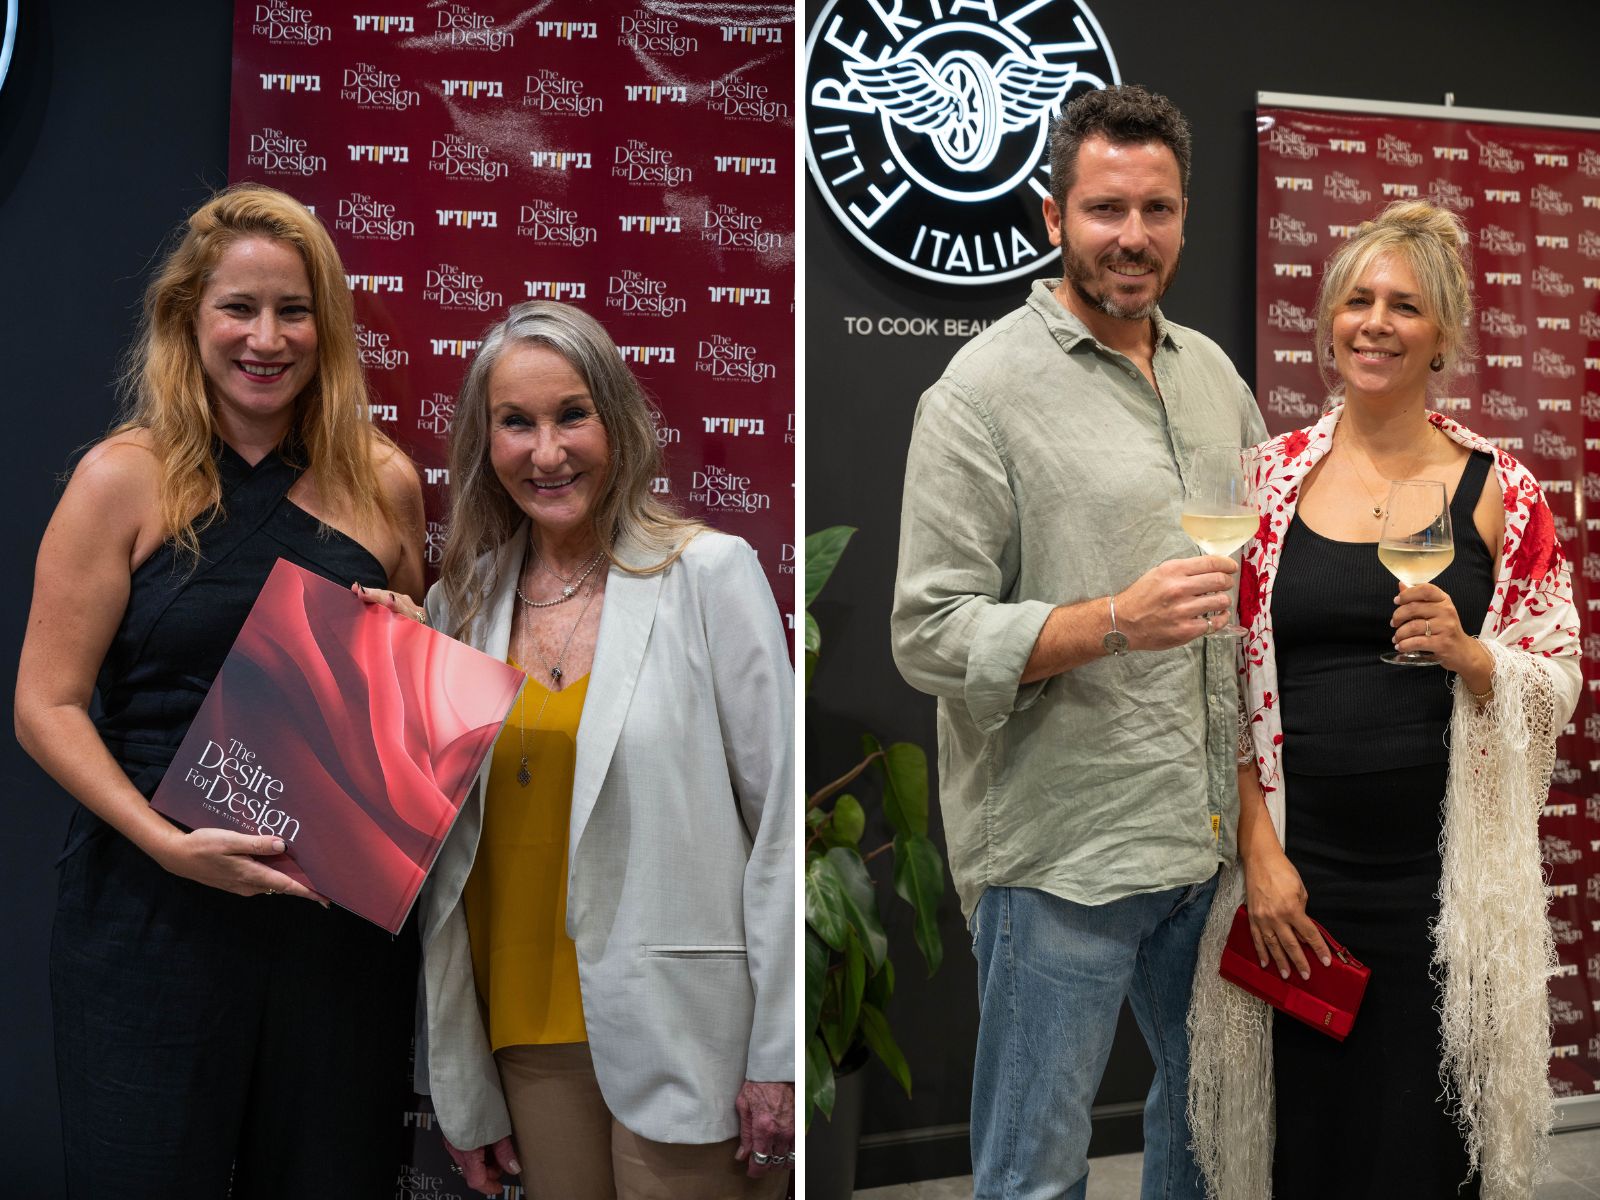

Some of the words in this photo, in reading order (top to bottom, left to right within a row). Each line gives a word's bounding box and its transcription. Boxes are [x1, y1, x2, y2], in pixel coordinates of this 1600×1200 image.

[255, 4, 312, 23] Desire
[450, 4, 470, 14] The
[633, 8, 652, 19] The
[438, 10, 494, 29] Desire
[620, 15, 678, 34] Desire
[252, 24, 269, 36] For
[269, 22, 332, 46] Design
[435, 30, 451, 41] For
[451, 28, 514, 52] Design
[634, 33, 697, 57] Design
[356, 62, 376, 73] The
[539, 68, 558, 79] The
[344, 69, 400, 88] Desire
[526, 75, 584, 94] Desire
[723, 74, 742, 84] The
[710, 80, 768, 99] Desire
[341, 89, 357, 100] For
[357, 87, 420, 111] Design
[524, 95, 540, 106] For
[540, 93, 603, 117] Design
[708, 100, 724, 111] For
[724, 98, 787, 122] Design
[263, 128, 282, 138] The
[444, 134, 464, 144] The
[1271, 130, 1307, 145] Desire
[250, 134, 308, 153] Desire
[432, 140, 488, 159] Desire
[628, 140, 648, 150] The
[1279, 143, 1319, 160] Design
[1377, 137, 1411, 152] Desire
[1479, 144, 1513, 159] Desire
[248, 154, 264, 165] For
[264, 152, 327, 176] Design
[616, 146, 672, 165] Desire
[1386, 150, 1423, 166] Design
[429, 160, 445, 171] For
[445, 158, 508, 182] Design
[1488, 157, 1525, 173] Design
[613, 166, 629, 177] For
[629, 164, 692, 188] Design
[1324, 174, 1360, 190] Desire
[351, 192, 370, 203] The
[1333, 188, 1372, 204] Design
[1531, 188, 1562, 201] Desire
[338, 199, 396, 218] Desire
[533, 198, 552, 209] The
[716, 204, 737, 214] The
[1539, 199, 1573, 214] Design
[520, 205, 578, 224] Desire
[704, 210, 762, 230] Desire
[336, 219, 352, 230] For
[352, 217, 415, 241] Design
[1270, 217, 1306, 232] Desire
[518, 225, 534, 236] For
[534, 223, 597, 247] Design
[701, 231, 718, 242] For
[718, 229, 782, 253] Design
[1278, 230, 1318, 247] Design
[1480, 227, 1514, 242] Desire
[910, 225, 1038, 272] ITALIA
[1489, 240, 1526, 256] Design
[439, 264, 458, 274] The
[622, 270, 642, 280] The
[1532, 270, 1563, 283] Desire
[426, 270, 484, 289] Desire
[610, 276, 666, 295] Desire
[1540, 281, 1574, 296] Design
[424, 290, 440, 301] For
[440, 288, 503, 312] Design
[607, 296, 623, 307] For
[623, 294, 686, 318] Design
[1270, 303, 1306, 318] Desire
[1481, 309, 1515, 324] Desire
[844, 317, 873, 335] TO
[878, 318, 939, 336] COOK
[1278, 316, 1318, 333] Design
[1490, 322, 1527, 338] Design
[710, 334, 731, 344] The
[698, 340, 756, 360] Desire
[1533, 351, 1565, 365] Desire
[695, 361, 712, 372] For
[712, 359, 776, 383] Design
[1541, 363, 1576, 378] Design
[433, 393, 453, 402] The
[1270, 389, 1306, 404] Desire
[1482, 392, 1516, 407] Desire
[1278, 402, 1318, 419] Design
[1491, 405, 1528, 421] Design
[418, 419, 434, 430] For
[1534, 432, 1566, 446] Desire
[1542, 444, 1577, 459] Design
[704, 465, 725, 475] The
[692, 471, 750, 491] Desire
[689, 492, 706, 503] For
[706, 490, 770, 514] Design
[228, 738, 256, 763] The
[198, 740, 284, 801] Desire
[185, 768, 212, 790] For
[205, 774, 300, 842] Design
[397, 1173, 443, 1191] esire
